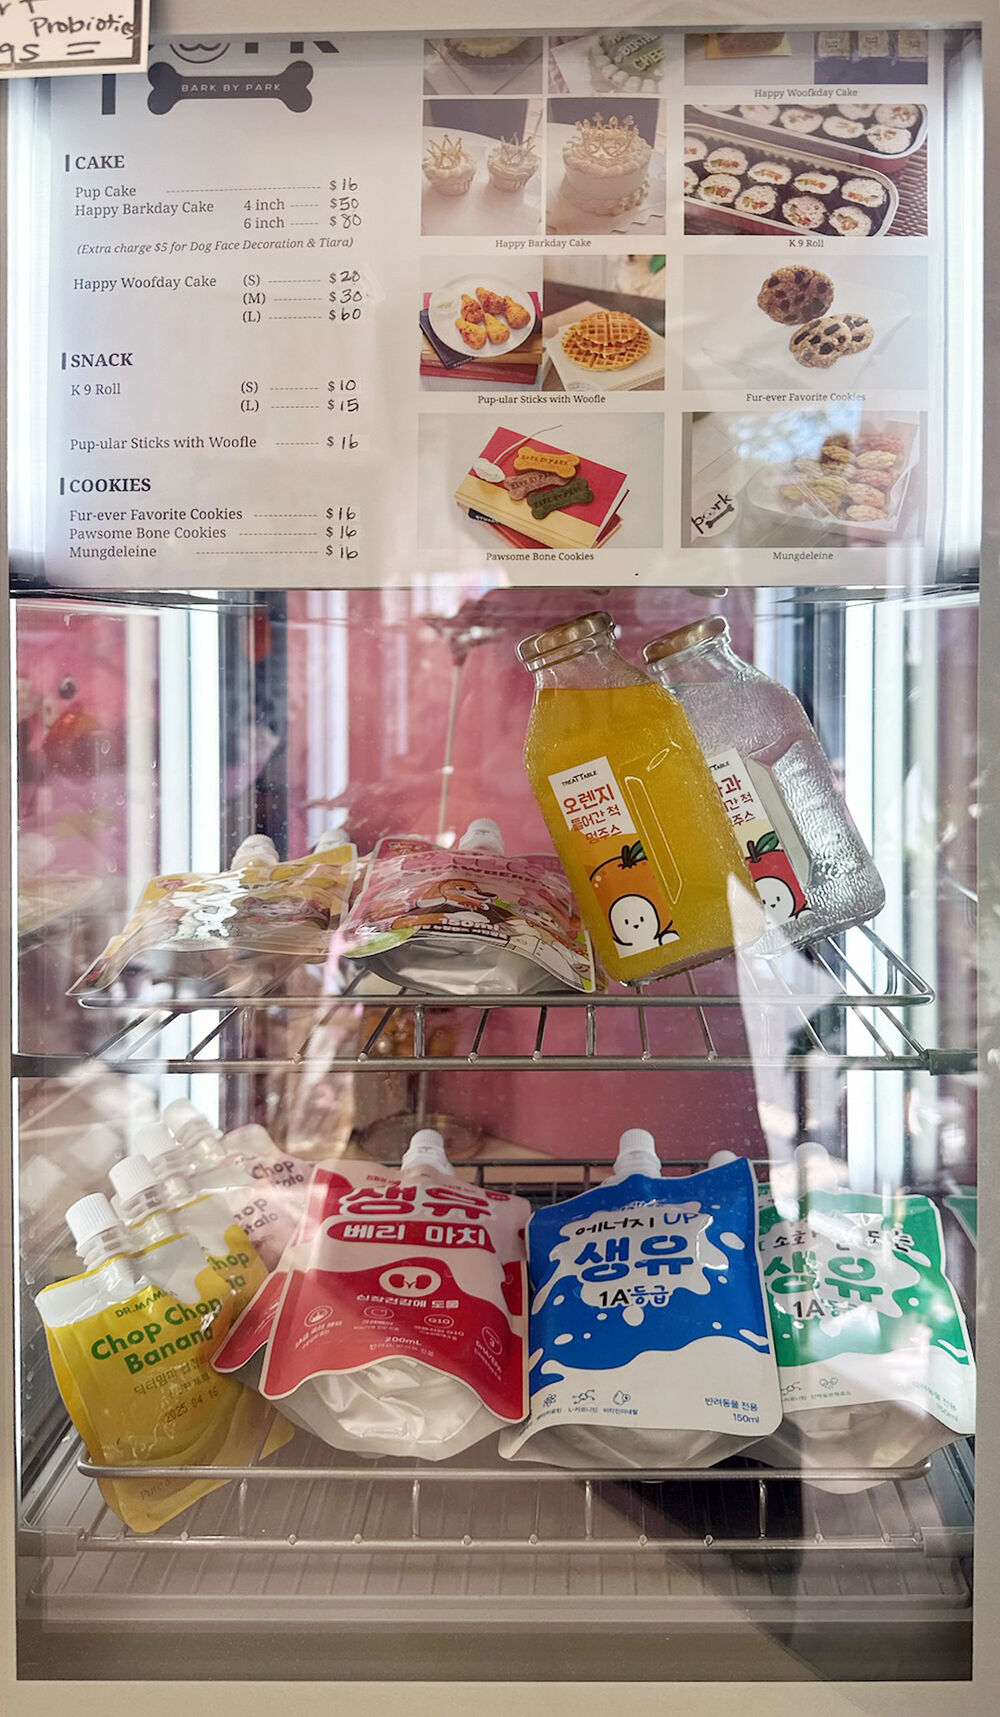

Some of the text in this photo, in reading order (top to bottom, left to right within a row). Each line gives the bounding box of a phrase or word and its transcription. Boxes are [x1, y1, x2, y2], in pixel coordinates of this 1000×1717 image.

[181, 83, 281, 93] BARK BY PARK
[754, 88, 858, 99] Happy Woofkday Cake
[75, 155, 125, 170] CAKE
[75, 187, 101, 200] Pup
[104, 185, 137, 198] Cake
[75, 204, 119, 218] Happy
[122, 202, 178, 216] Barkday
[182, 201, 214, 214] Cake
[243, 200, 251, 211] 4
[255, 198, 285, 211] inch
[243, 218, 251, 229] 6
[255, 217, 285, 229] inch
[77, 237, 354, 255] (Extra charge $5 for Dog Face Decoration & Tiara)
[495, 238, 592, 250] Happy Barkday Cake
[798, 239, 804, 247] 9
[806, 239, 824, 248] Roll
[73, 277, 117, 291] Happy
[121, 276, 181, 290] Woofday
[184, 275, 217, 287] Cake
[243, 274, 261, 287] (S)
[243, 292, 266, 305] (M)
[242, 310, 261, 323] (L)
[70, 353, 133, 368] SNACK
[71, 384, 80, 396] K
[84, 384, 91, 395] 9
[96, 383, 121, 395] Roll
[240, 381, 259, 394] (S)
[477, 394, 606, 405] Pup-ular Sticks with Woofle
[746, 392, 866, 402] Fur-ever Favorite Cookies
[240, 400, 260, 412] (L)
[70, 437, 128, 452] Pup-ular
[131, 436, 170, 449] Sticks
[173, 436, 205, 449] with
[209, 435, 257, 448] Woofle
[70, 478, 151, 493] COOKIES
[69, 509, 127, 522] Fur-ever
[130, 508, 187, 521] Favorite
[190, 507, 243, 520] Cookies
[69, 527, 132, 540] Pawsome
[136, 527, 170, 539] Bone
[174, 526, 227, 539] Cookies
[69, 545, 157, 561] Mungdeleine
[486, 551, 595, 561] Pawsome Bone Cookies
[772, 551, 834, 561] Mungdeleine
[563, 783, 615, 815] 오렌지
[346, 1182, 492, 1220] 생유
[575, 1212, 699, 1236] 에너지 UP
[343, 1224, 486, 1246] 베리 마치
[574, 1235, 694, 1283] 생유
[91, 1321, 162, 1361] Chop
